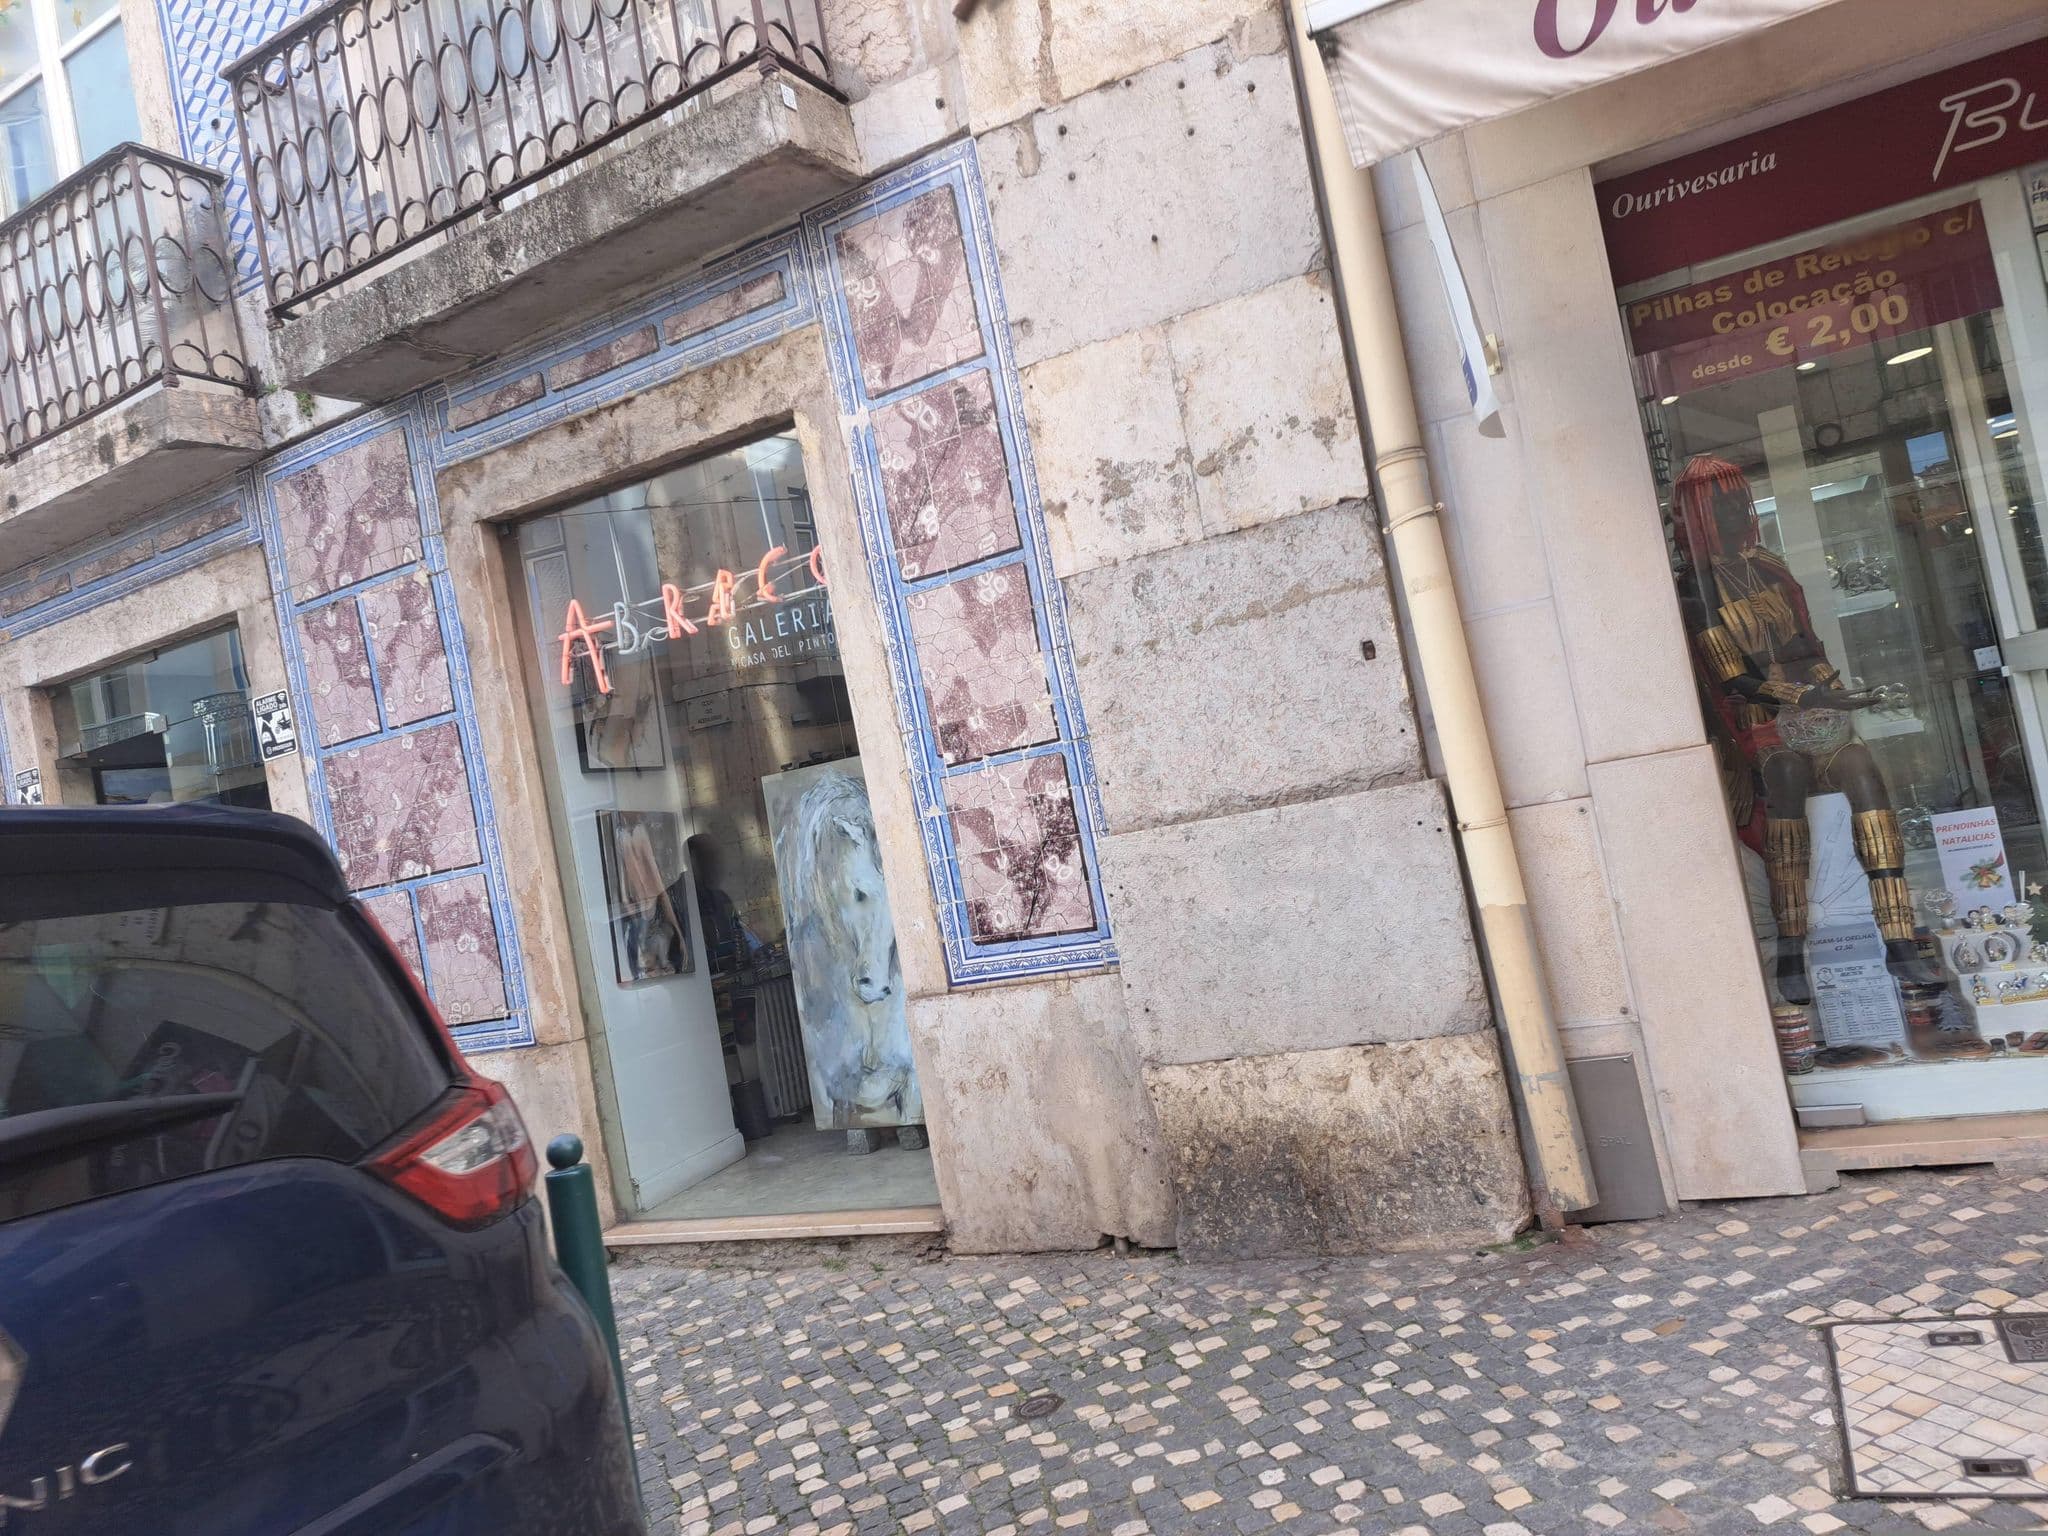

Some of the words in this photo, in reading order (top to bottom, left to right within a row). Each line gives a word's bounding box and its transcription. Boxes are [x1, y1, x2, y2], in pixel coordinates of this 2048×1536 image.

[1612, 151, 1777, 219] Ourivesaria
[1632, 284, 1733, 328] Pilhas
[1743, 267, 1785, 295] de
[1942, 205, 1974, 237] c/
[1711, 268, 1898, 334] Colocação
[1691, 353, 1753, 380] desde
[1765, 326, 1795, 357] €
[1807, 294, 1910, 349] 2,00
[740, 651, 766, 669] CASA
[771, 645, 791, 659] DEL
[1936, 818, 1996, 833] PRENDINHAS
